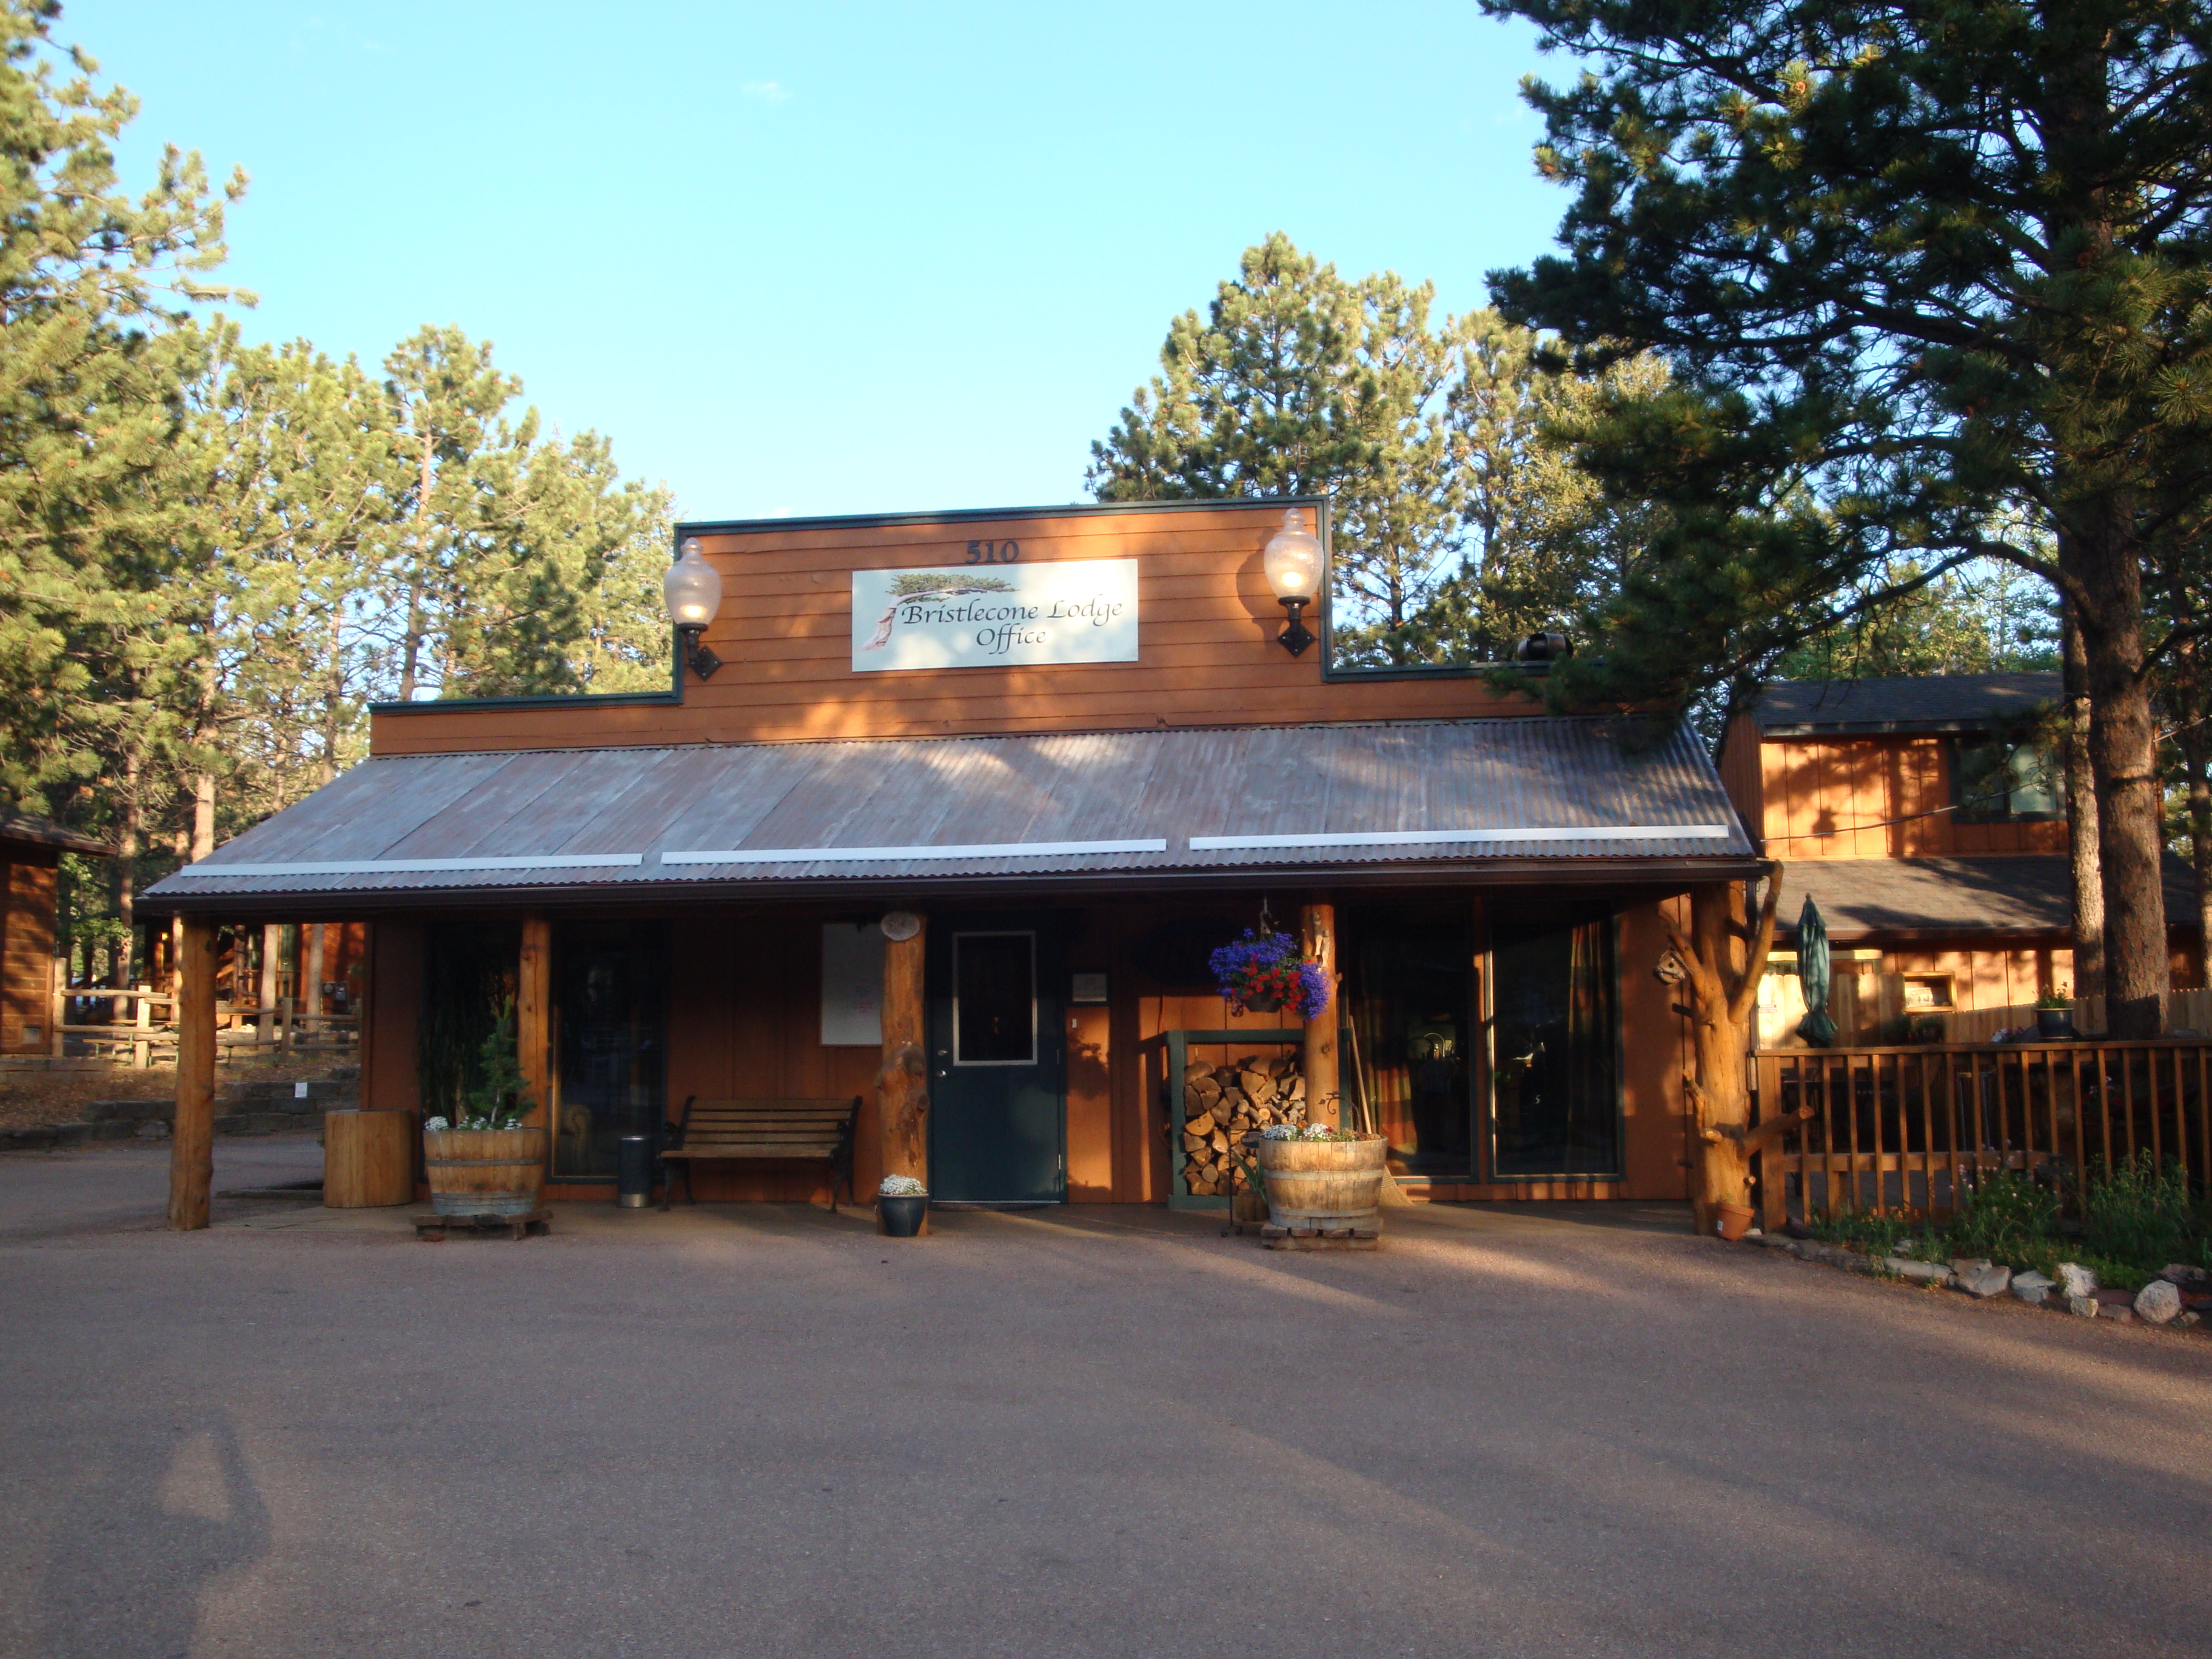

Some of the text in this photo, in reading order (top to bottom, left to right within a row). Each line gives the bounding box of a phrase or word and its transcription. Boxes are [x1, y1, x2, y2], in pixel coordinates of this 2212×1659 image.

[965, 540, 1019, 564] 510
[901, 594, 1123, 627] Bristlecone Lodge
[976, 623, 1047, 655] Office
